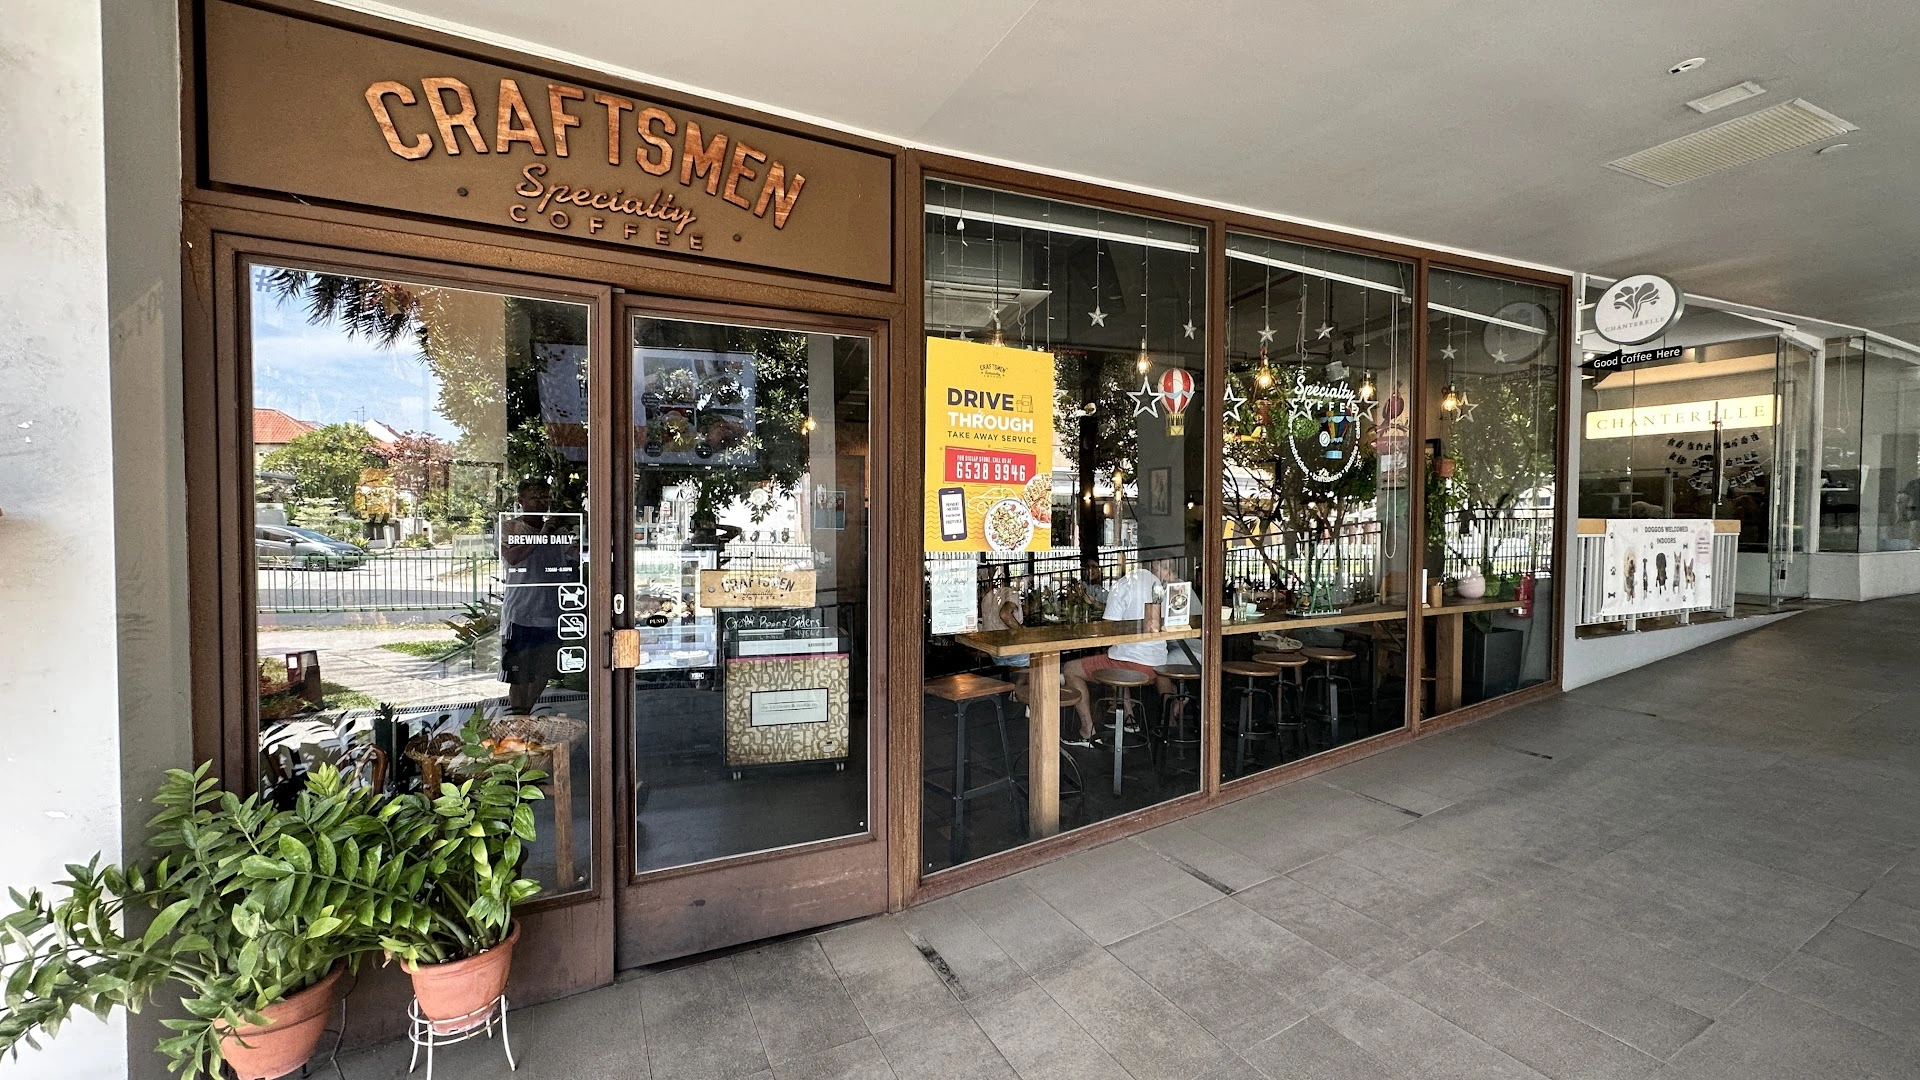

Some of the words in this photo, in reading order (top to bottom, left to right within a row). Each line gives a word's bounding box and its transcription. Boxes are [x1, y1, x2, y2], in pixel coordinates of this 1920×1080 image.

[364, 76, 806, 230] CRAFTSMEN
[515, 162, 698, 235] Specialty
[508, 204, 704, 251] COFFEE
[1604, 317, 1665, 333] CHANTERELLE
[1593, 355, 1618, 369] Good
[1620, 351, 1652, 365] Coffee
[1656, 348, 1680, 359] Here
[947, 387, 1015, 412] DRIVE
[1294, 375, 1356, 408] Specialty
[1292, 397, 1359, 414] COFFEE
[947, 411, 1034, 433] THROUGH
[947, 430, 971, 440] TAKE
[974, 432, 998, 441] AWAY
[1001, 434, 1037, 444] SERVICE
[956, 461, 989, 480] 6538
[994, 463, 1026, 482] 9946
[508, 534, 548, 545] BREWING
[550, 534, 574, 545] DAILY
